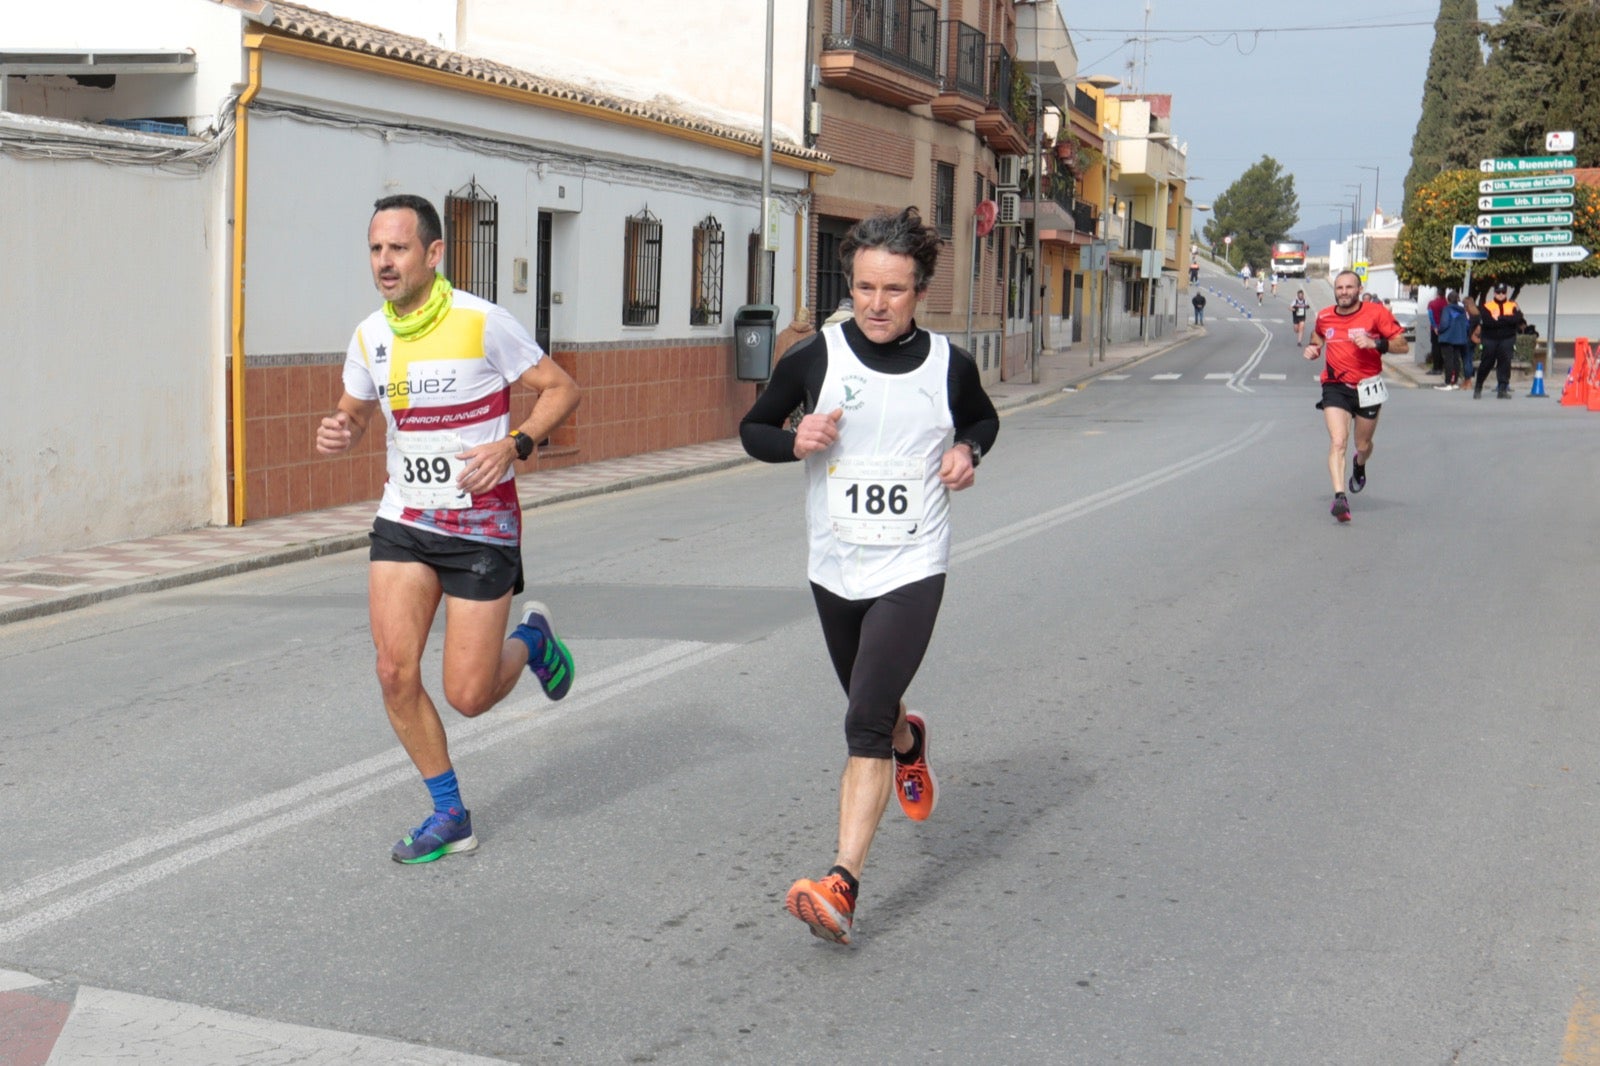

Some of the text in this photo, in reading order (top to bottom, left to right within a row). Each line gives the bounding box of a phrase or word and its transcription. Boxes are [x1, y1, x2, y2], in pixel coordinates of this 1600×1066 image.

[1496, 159, 1574, 170] Urb. Buenavista
[1509, 181, 1532, 189] Parque
[1533, 179, 1543, 187] del
[1545, 178, 1571, 186] Cubillas
[1514, 197, 1530, 205] Urb.
[1503, 216, 1519, 224] Urb.
[1521, 215, 1545, 223] Monte
[1500, 233, 1568, 243] Urb. Cortijo Pretel
[1364, 382, 1384, 396] 111
[441, 405, 490, 422] RUNNERS
[404, 457, 451, 483] 389
[845, 483, 908, 515] 186
